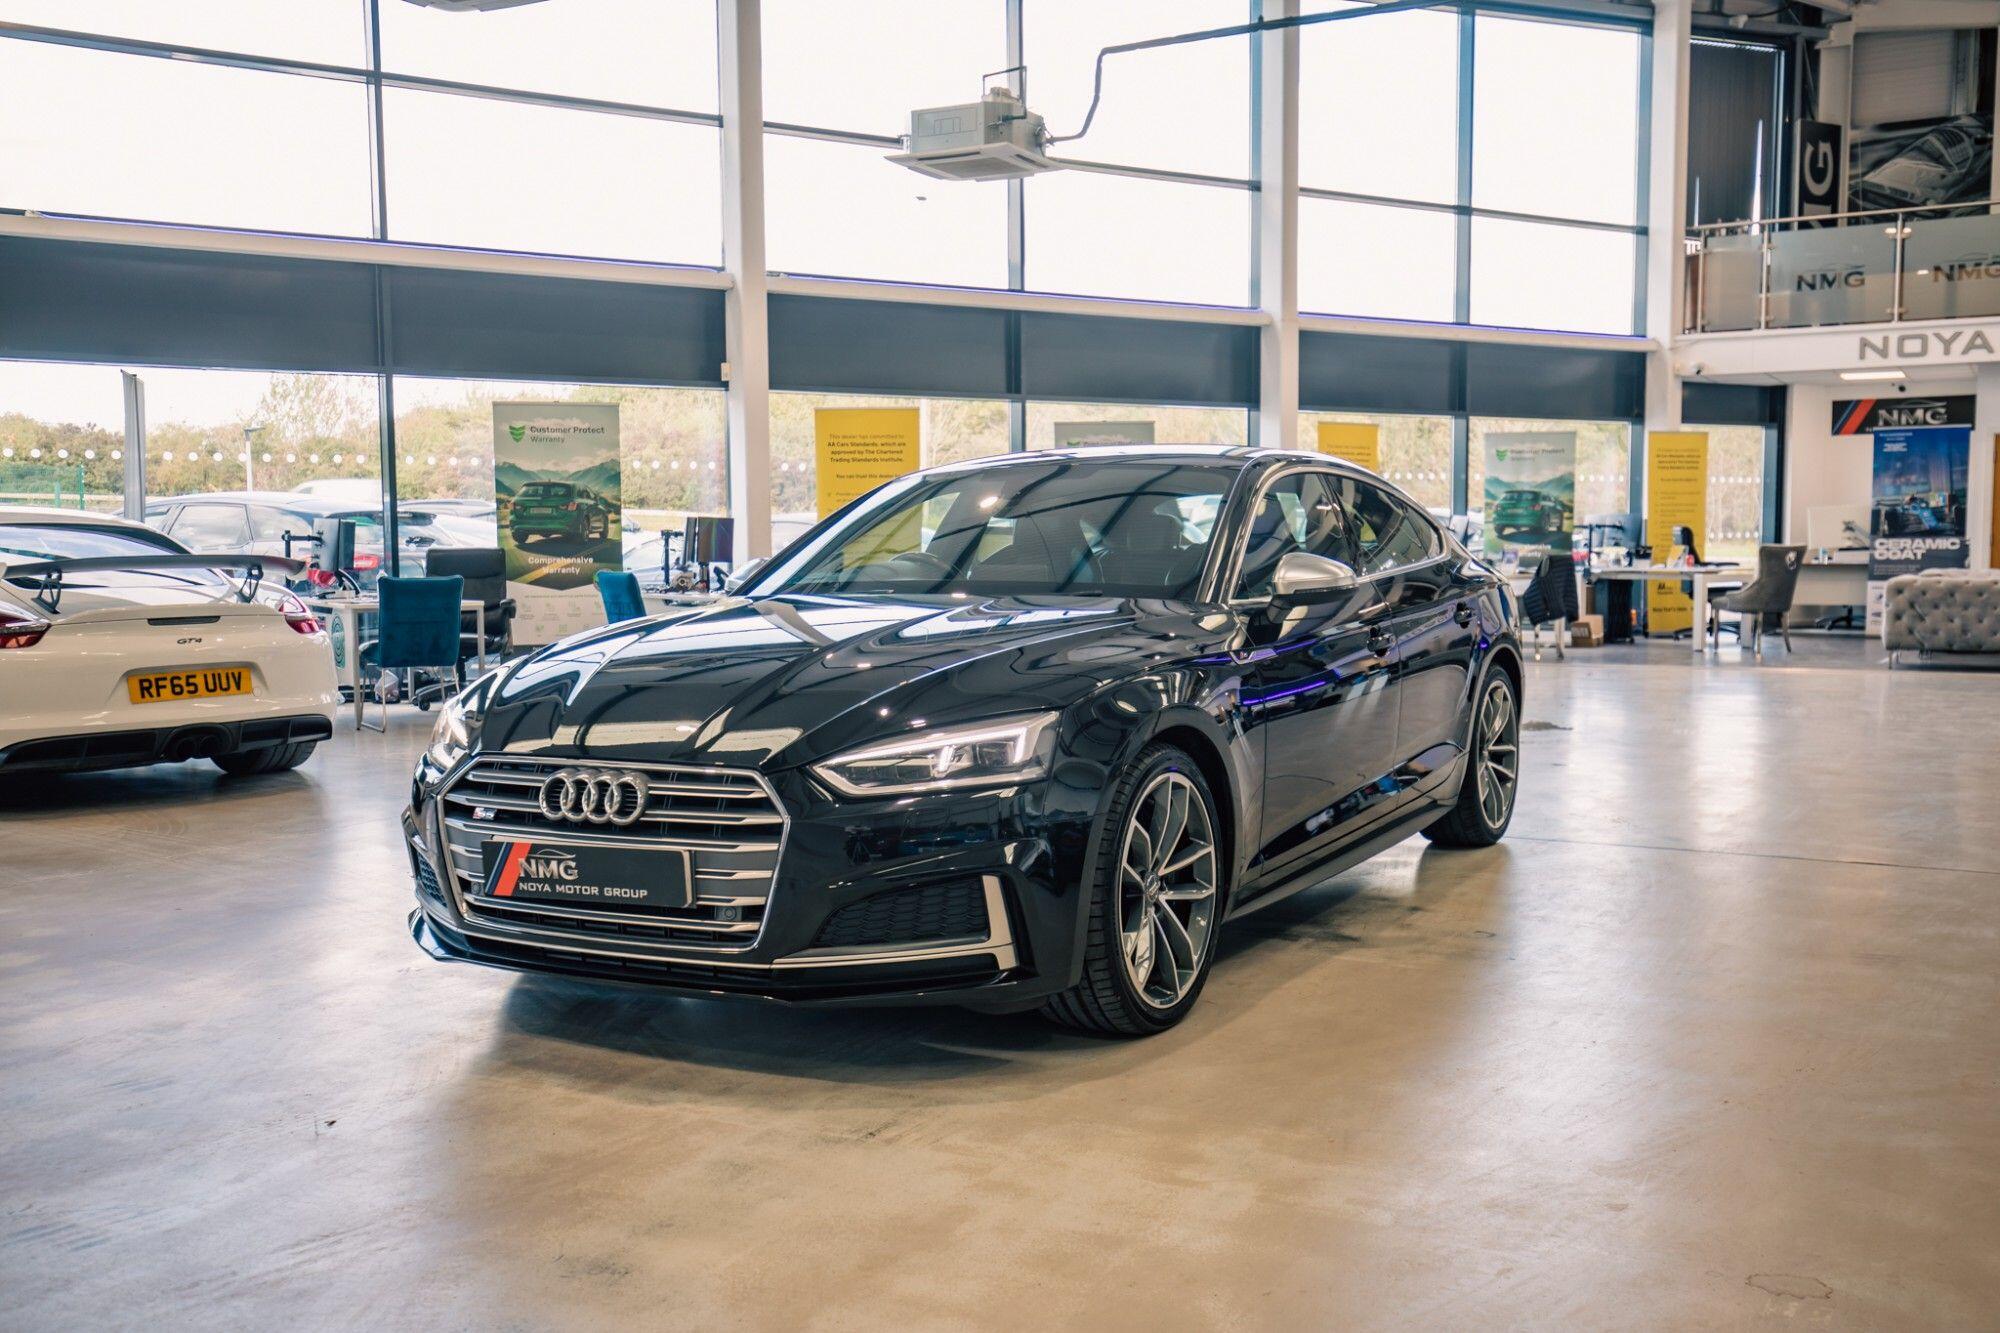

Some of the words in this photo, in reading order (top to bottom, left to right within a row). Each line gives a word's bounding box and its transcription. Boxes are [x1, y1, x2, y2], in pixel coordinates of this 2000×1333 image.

[1797, 271, 1866, 292] NMG
[1858, 330, 1994, 360] NOYA
[1877, 407, 1948, 426] NMG
[530, 426, 571, 434] Customer
[573, 426, 605, 434] Protect
[1874, 538, 1961, 550] CERAMIC
[528, 556, 594, 564] Comprehensive
[1873, 549, 1926, 560] COAT
[542, 566, 581, 575] Warranty
[176, 637, 203, 645] GT4
[139, 674, 199, 699] RF65
[203, 671, 242, 693] UUV
[518, 857, 579, 881] NMG
[519, 882, 551, 892] NOYA
[555, 884, 600, 896] MOTOR
[604, 887, 648, 898] GROUP
